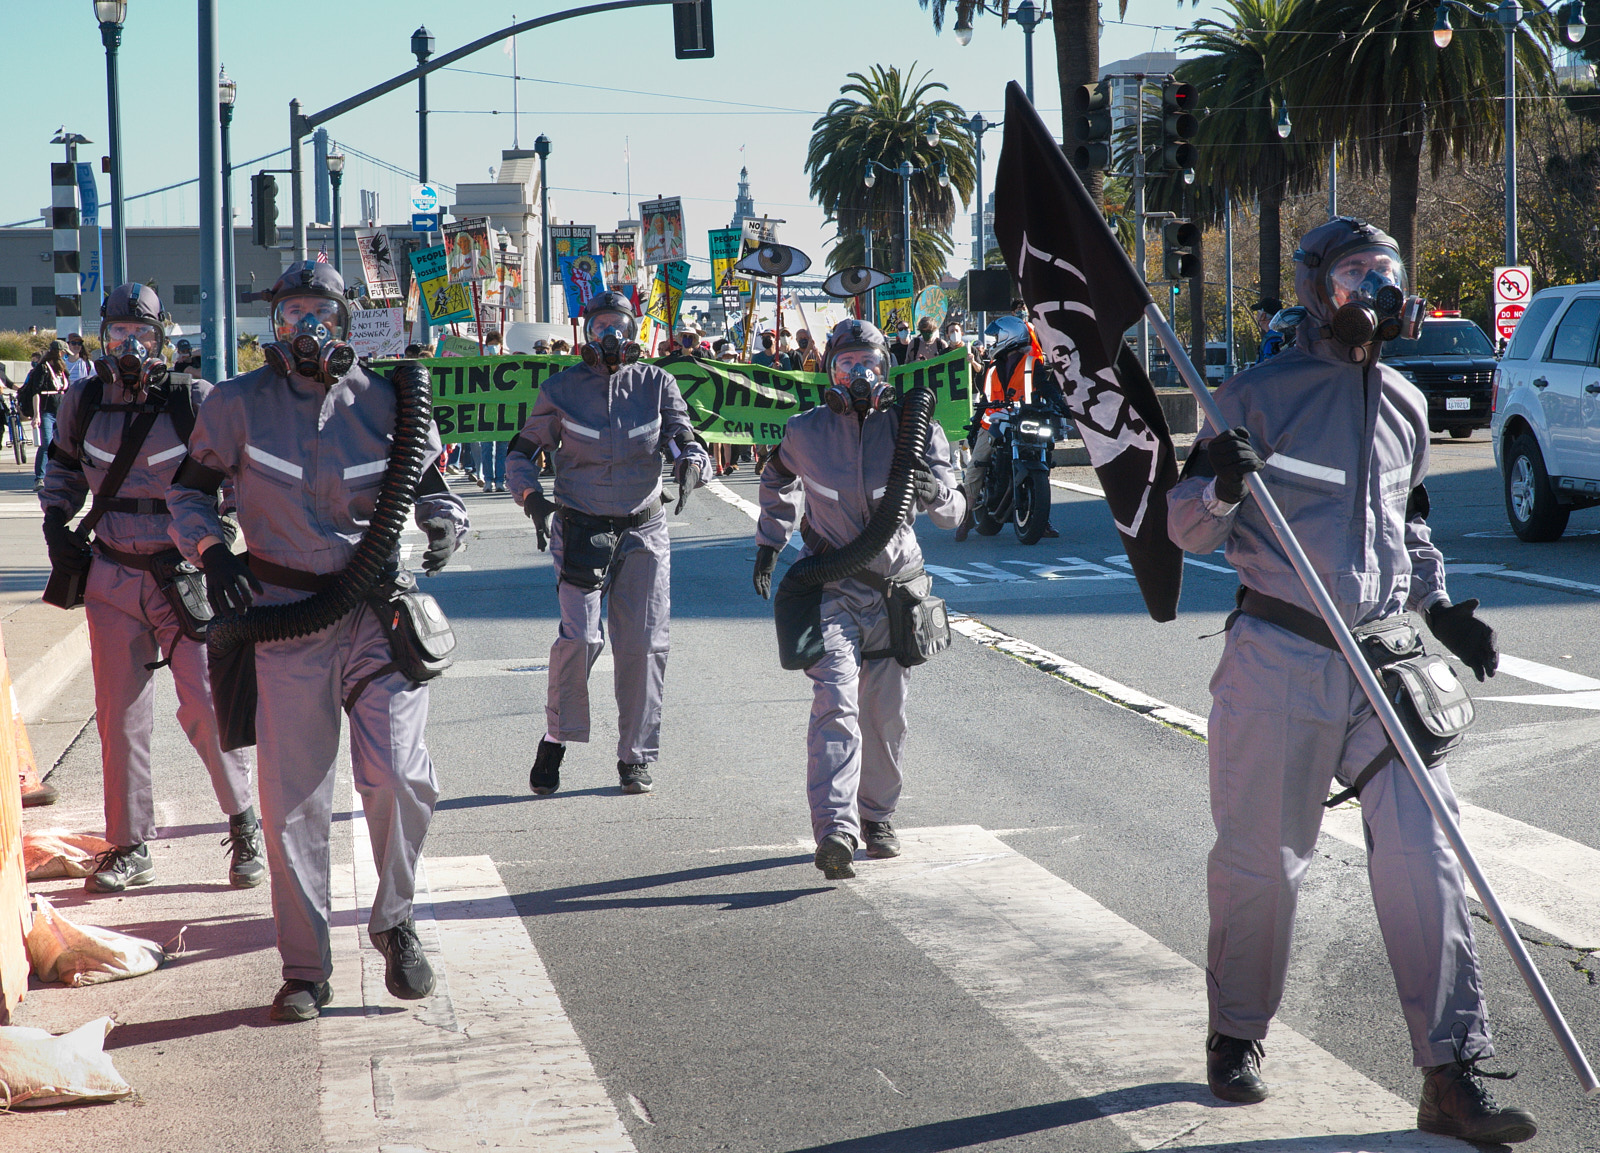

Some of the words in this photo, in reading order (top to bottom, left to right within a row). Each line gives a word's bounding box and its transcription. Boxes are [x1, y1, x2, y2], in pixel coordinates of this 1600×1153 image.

[79, 165, 97, 217] PIER
[552, 228, 571, 237] BUILD
[573, 227, 591, 237] BACK
[714, 235, 741, 243] PEOPL
[91, 251, 99, 271] PIER
[417, 267, 438, 278] FOSSIL
[668, 261, 684, 273] OPLE
[80, 272, 99, 293] 27
[553, 273, 562, 281] FO
[890, 276, 908, 284] OPLE
[371, 288, 400, 296] FUTURE
[920, 288, 945, 310] LOVE
[352, 309, 389, 320] PITALISM
[358, 322, 371, 330] NOT
[375, 321, 390, 329] THE
[433, 402, 527, 435] BELLI
[723, 420, 754, 438] SAN
